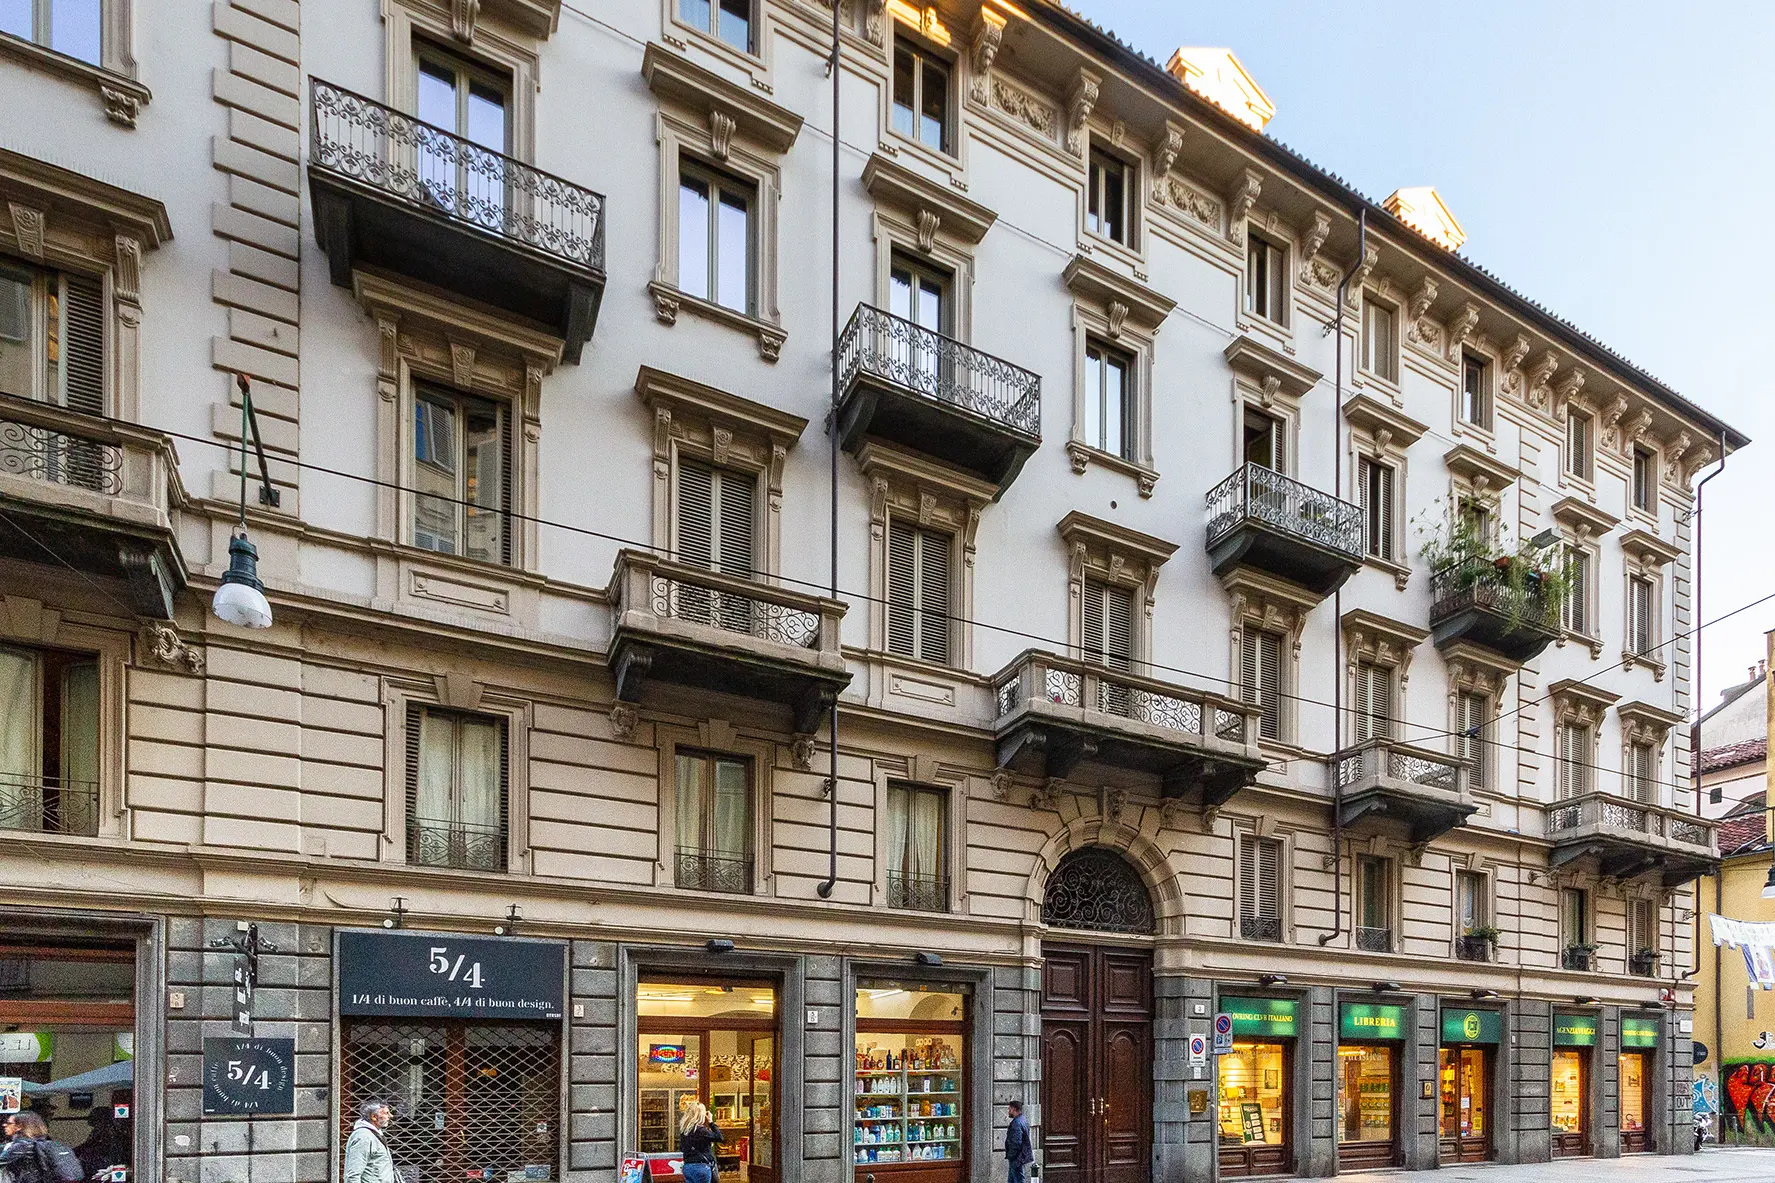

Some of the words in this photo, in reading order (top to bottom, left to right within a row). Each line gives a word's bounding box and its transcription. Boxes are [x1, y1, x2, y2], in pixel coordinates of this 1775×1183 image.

[429, 947, 485, 988] 5/4
[352, 994, 370, 1004] 1/4
[374, 994, 385, 1005] di
[389, 995, 418, 1006] buon
[453, 997, 471, 1007] 4/4
[475, 997, 486, 1007] di
[488, 998, 515, 1008] buon
[517, 998, 554, 1011] design.
[1232, 1012, 1253, 1021] OVRING
[1268, 1014, 1293, 1022] ITALIANO
[1353, 1016, 1396, 1027] LIBRERIA
[227, 1060, 272, 1090] 5/4
